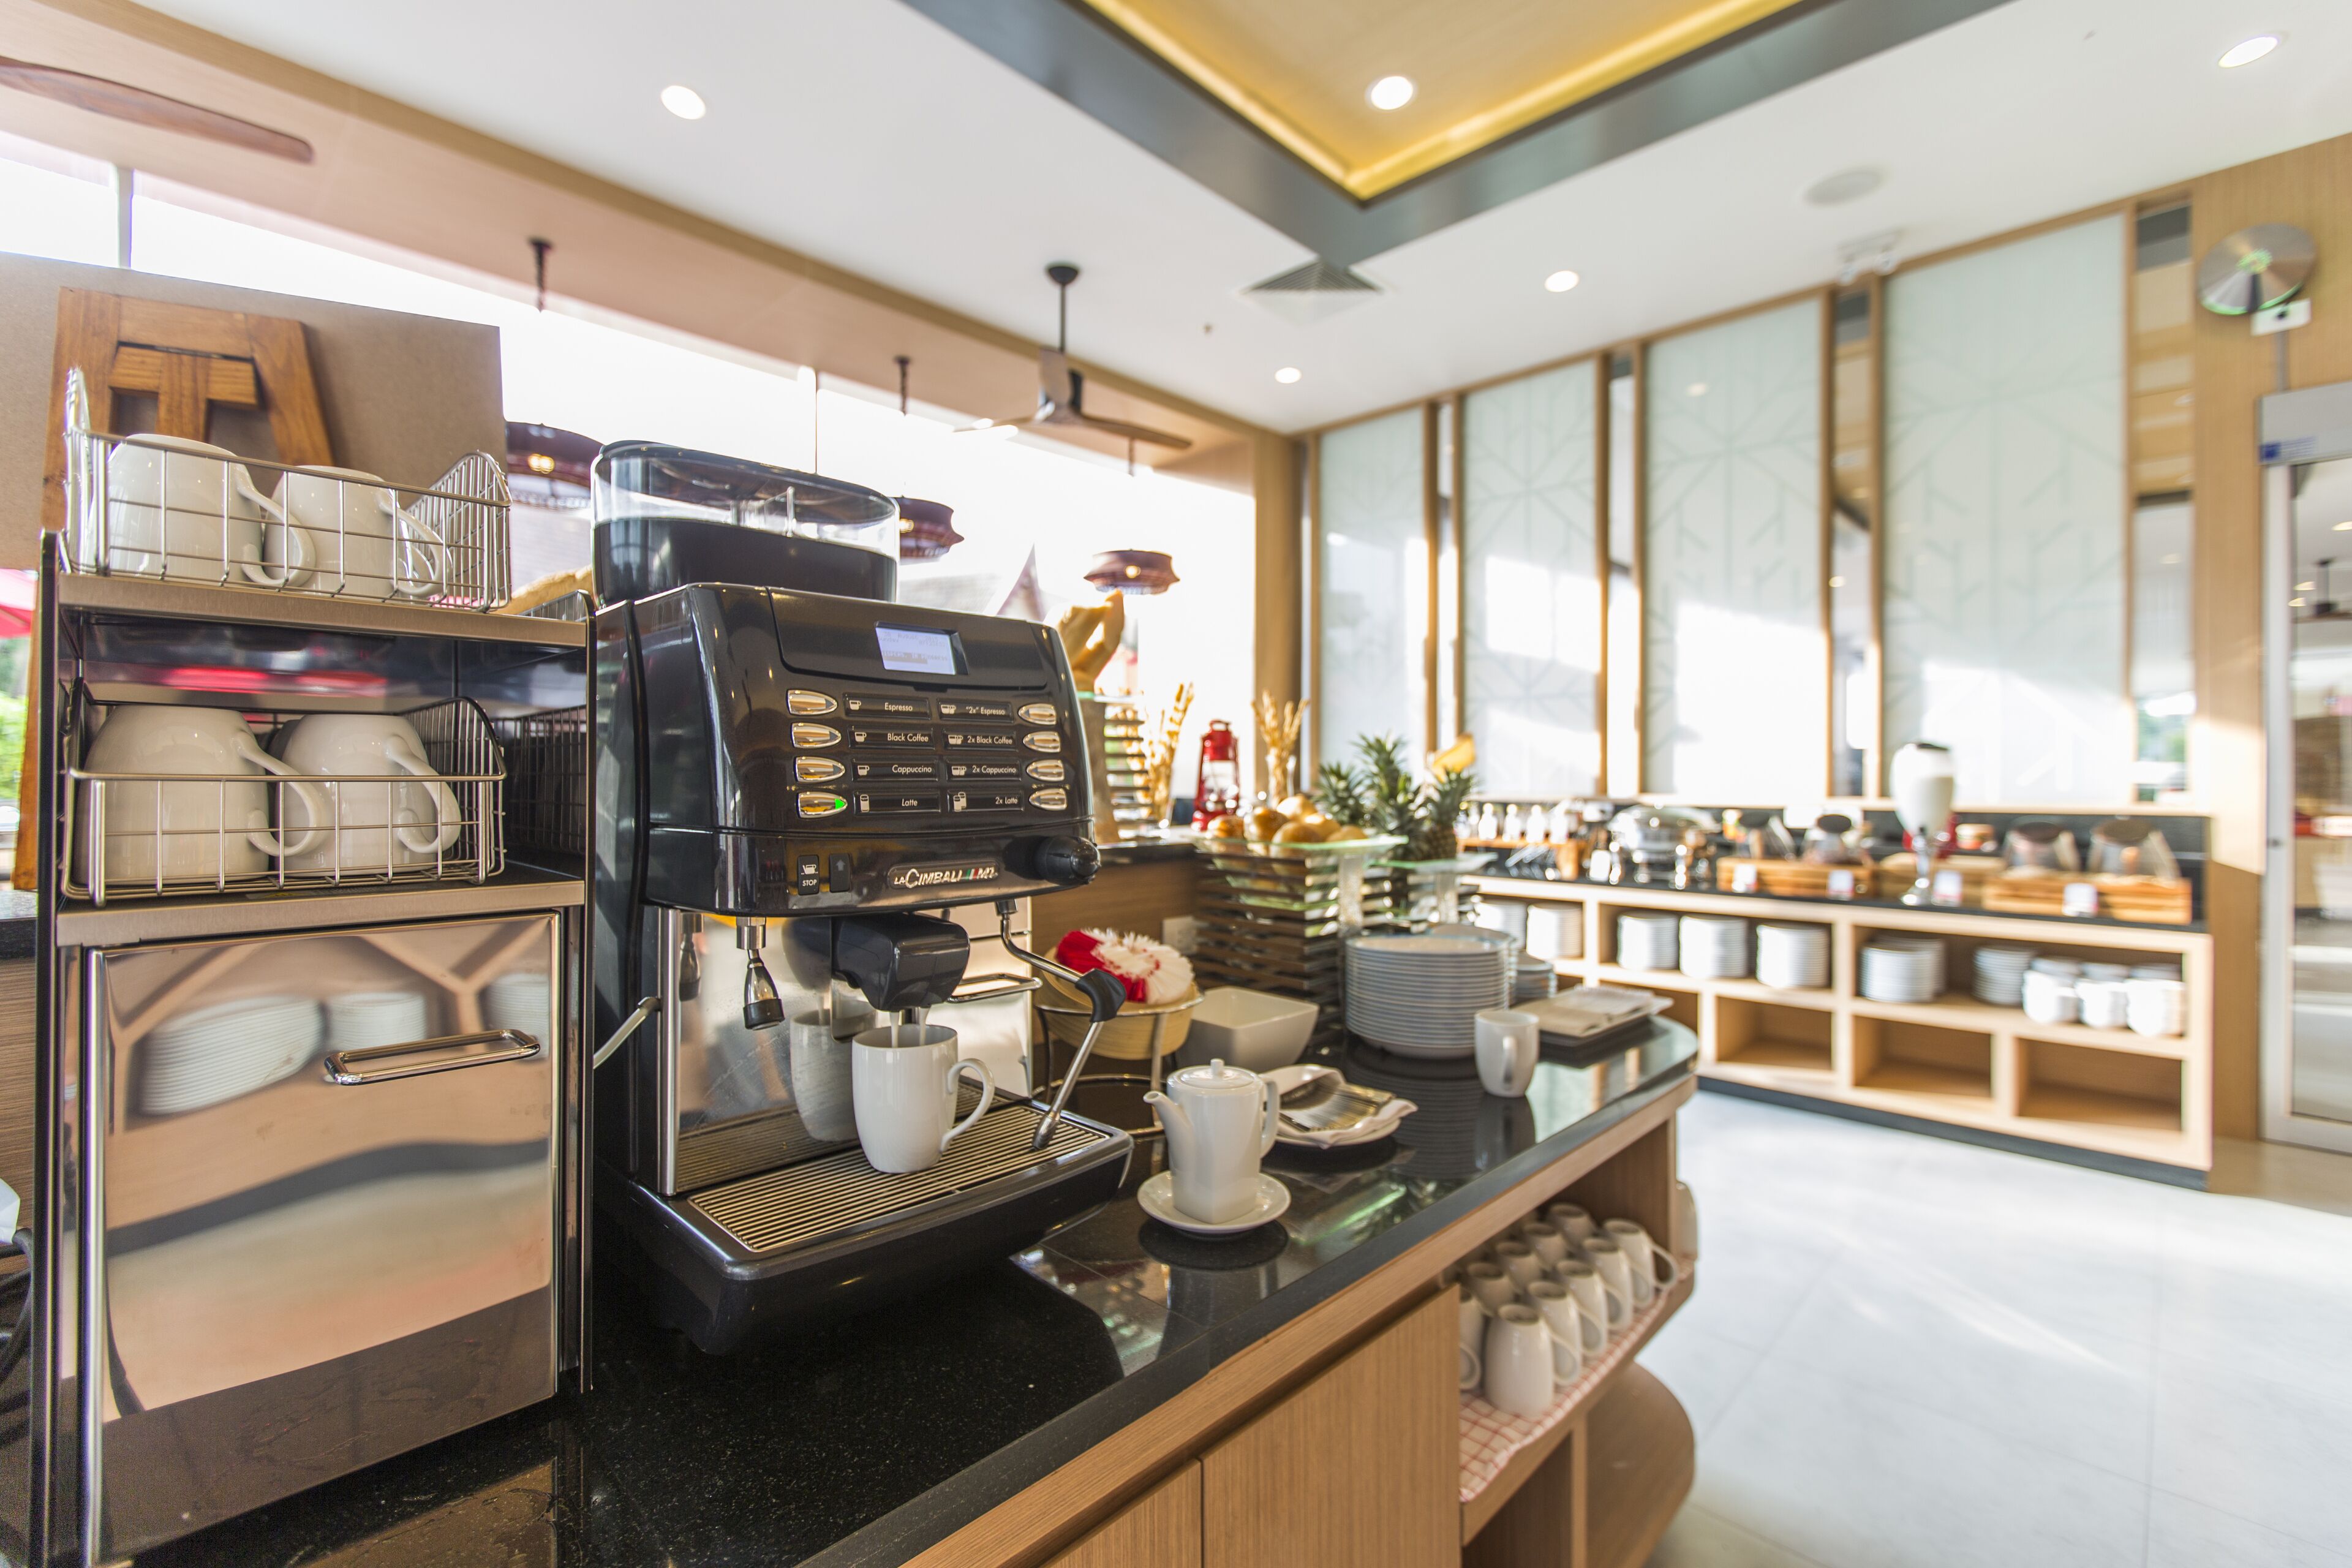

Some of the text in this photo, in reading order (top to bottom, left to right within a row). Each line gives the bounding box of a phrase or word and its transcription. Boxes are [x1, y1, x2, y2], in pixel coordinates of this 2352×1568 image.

[884, 702, 913, 712] Espresso
[981, 706, 1005, 715] Espresso
[888, 733, 929, 742] Black Coffee
[993, 736, 1012, 745] Coffee
[892, 764, 932, 775] Cappuccino
[981, 765, 1017, 775] Cappuccino
[902, 798, 918, 807] Latte
[894, 876, 906, 884] LA
[905, 868, 963, 888] CIMBALI
